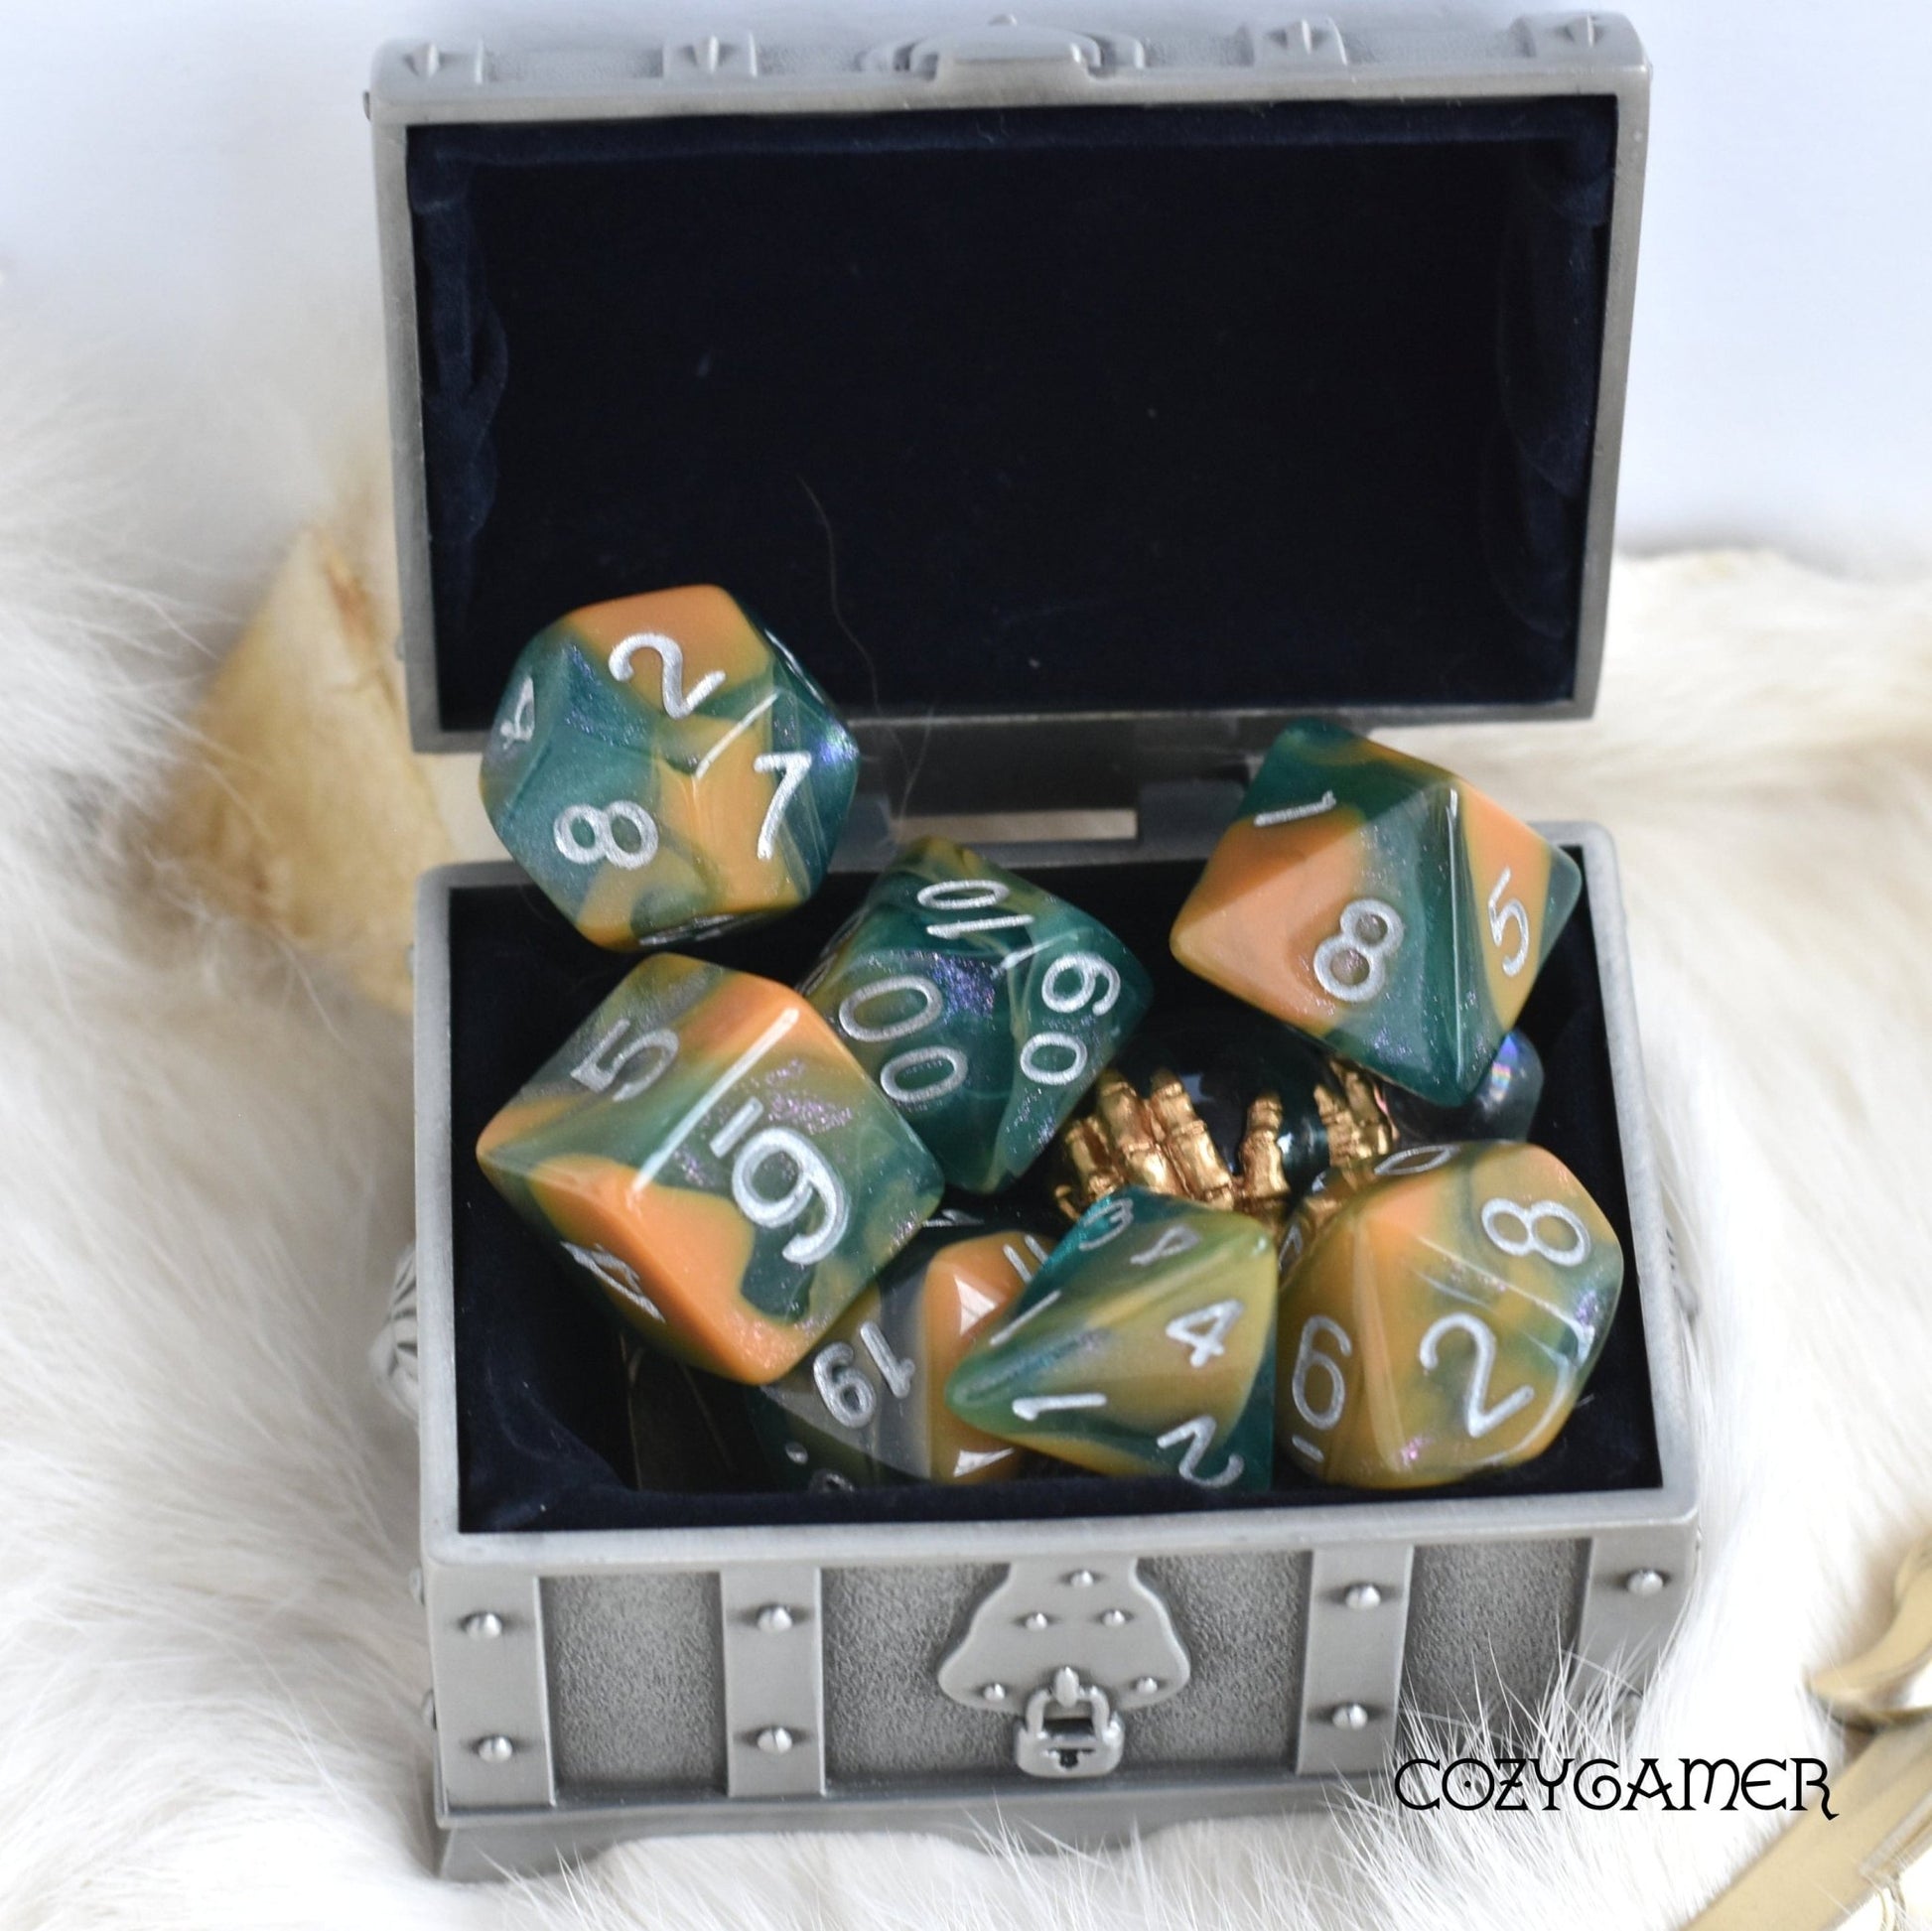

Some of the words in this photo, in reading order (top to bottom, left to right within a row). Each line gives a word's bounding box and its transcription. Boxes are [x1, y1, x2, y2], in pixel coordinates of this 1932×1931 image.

[609, 632, 728, 719] 2
[553, 800, 659, 870] 8
[754, 750, 813, 862] 7
[1312, 898, 1405, 1003] 8
[1487, 866, 1530, 977] 5
[570, 1019, 680, 1102] 5
[1481, 1197, 1590, 1268] 8
[1165, 1299, 1245, 1368] 4
[1011, 1392, 1109, 1422] 1
[1419, 1311, 1535, 1440] 2
[1156, 1415, 1245, 1488] 2
